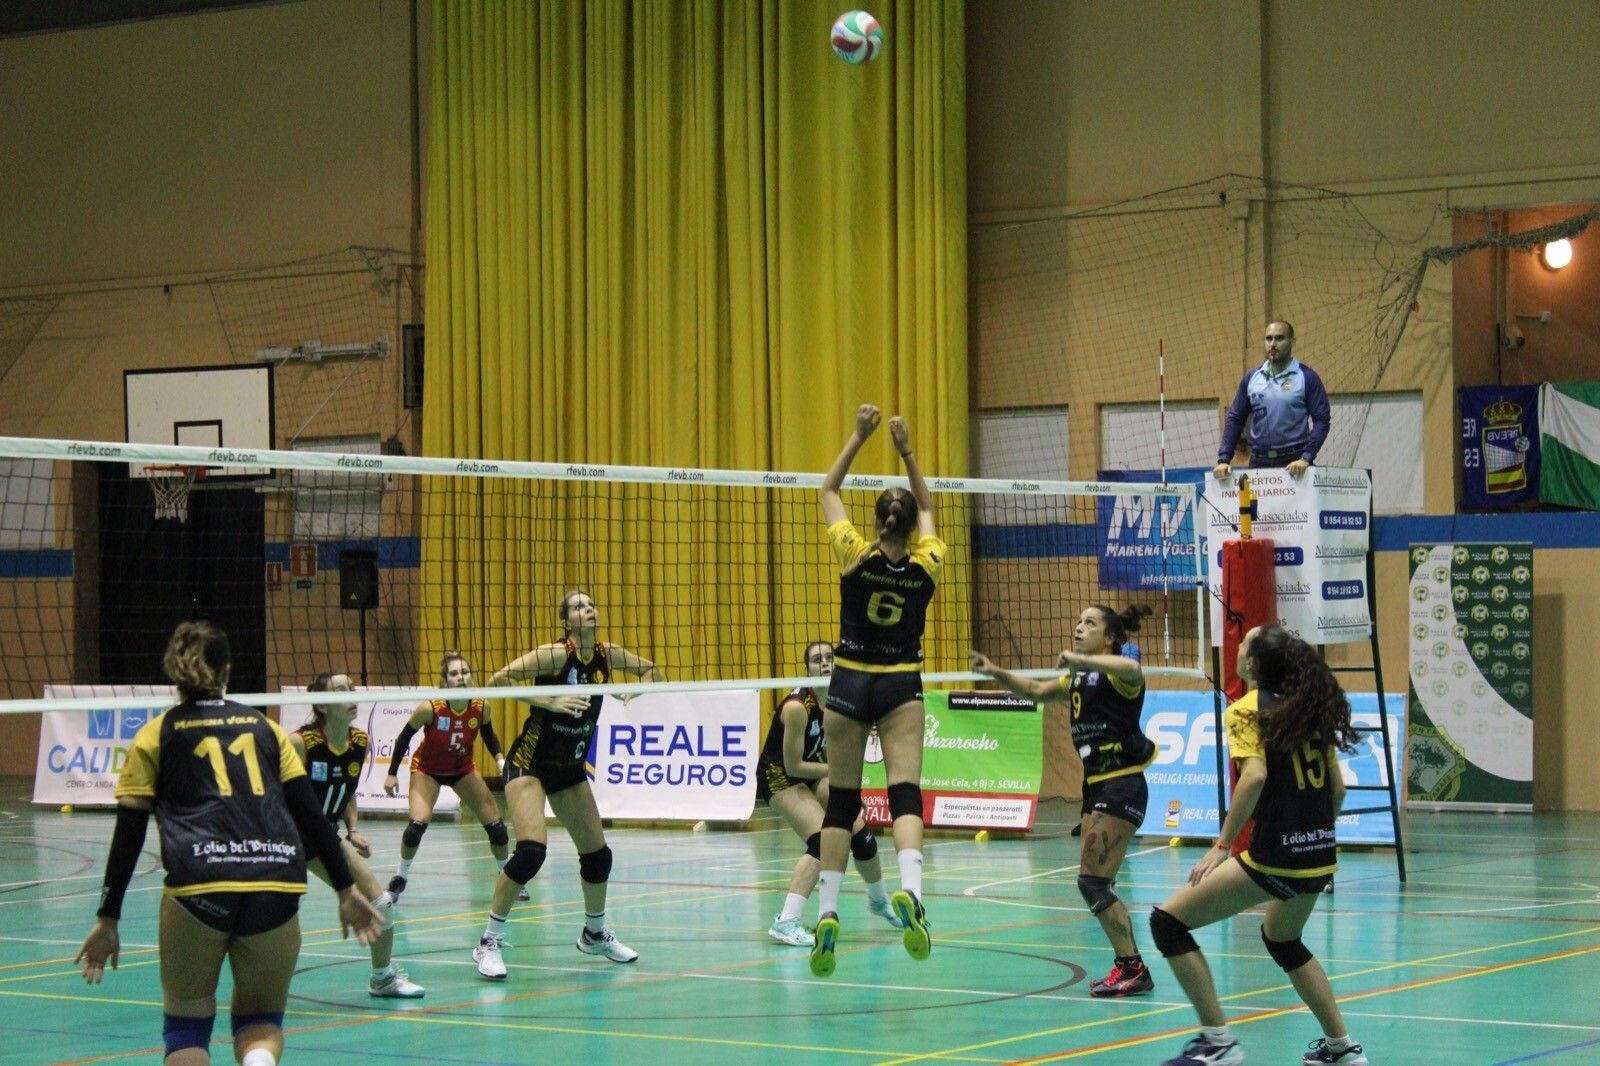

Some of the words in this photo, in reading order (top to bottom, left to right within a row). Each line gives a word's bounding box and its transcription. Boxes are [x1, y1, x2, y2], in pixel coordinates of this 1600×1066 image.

[67, 443, 121, 457] rfevb.com
[208, 449, 258, 463] rfevb.com
[337, 456, 383, 468] rfevb.com
[456, 461, 499, 473] rfevb.com
[566, 467, 605, 477] rfevb.com
[667, 471, 704, 481] rfevb.com
[762, 473, 797, 484] rfevb.com
[851, 476, 884, 487] rfevb.com
[934, 479, 964, 490] rfevb.com
[1011, 481, 1040, 491] rfevb.com
[1084, 484, 1111, 493] rfevb.com
[867, 591, 905, 625] 6
[951, 697, 1034, 706] www.elpanzerocho.com
[1072, 691, 1081, 719] 9
[608, 725, 748, 757] REALE
[48, 745, 128, 774] CALID
[194, 733, 265, 797] 11
[606, 763, 748, 787] SEGUROS
[932, 777, 950, 787] José
[972, 779, 979, 787] 4
[998, 780, 1031, 789] SEVILLA
[1182, 808, 1203, 819] REAL
